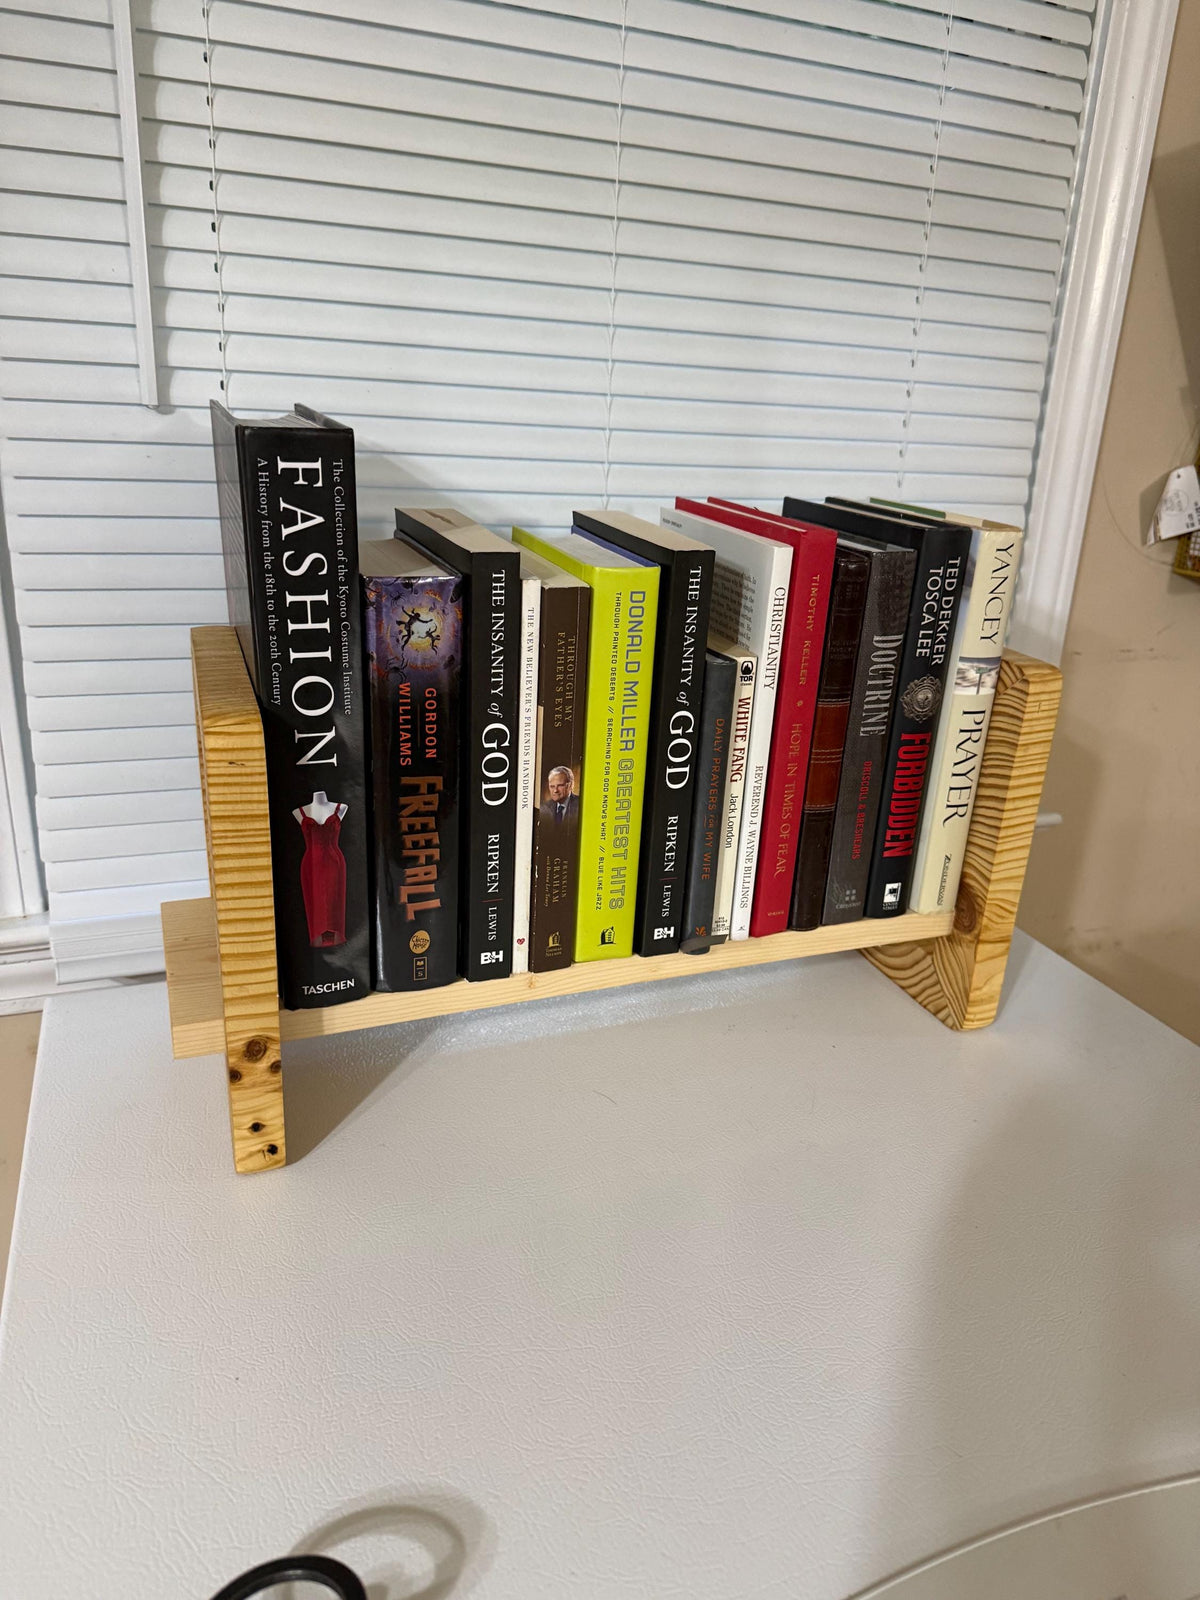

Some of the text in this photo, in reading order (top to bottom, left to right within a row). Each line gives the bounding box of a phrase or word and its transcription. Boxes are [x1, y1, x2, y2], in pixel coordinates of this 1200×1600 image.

[257, 457, 282, 706] A History from the 18th to the 20th Century
[332, 459, 352, 714] The Collection of the Kyoto Costume Institute
[980, 542, 1015, 645] YANCEY
[277, 456, 338, 767] FASHION
[527, 607, 535, 628] THE
[614, 592, 622, 629] THROUGH
[763, 587, 786, 690] CHRISTIANITY
[915, 566, 944, 658] TOSCA LEE
[931, 557, 961, 666] TED DEKKER
[611, 631, 619, 665] PAINTED
[481, 570, 510, 807] THE INSANITY of GOD
[525, 657, 533, 713] BELIEVER'S
[554, 632, 566, 728] FATHER'S EYES
[564, 636, 575, 722] THROUGH MY
[608, 667, 617, 701] DESERTS
[665, 566, 702, 790] THE INSANITY of GOD
[860, 634, 904, 737] DOCTRINE
[399, 682, 412, 767] WILLIAMS
[425, 687, 437, 759] GORDON
[523, 716, 532, 761] FRIENDS
[605, 718, 613, 759] SEARCHING
[713, 718, 725, 753] DAILY
[733, 697, 752, 744] WHITE
[774, 574, 820, 880] TIMOTHY KELLER HOPE IN TIMES OF FEAR
[609, 590, 646, 910] DONALD MILLER GREATEST HITS
[730, 746, 748, 783] FANG
[942, 709, 986, 828] PRAYER
[521, 760, 531, 810] HANDBOOK
[708, 758, 721, 811] PRAYERS
[750, 765, 764, 818] REVEREND
[859, 760, 873, 802] DRISCOLL
[882, 732, 932, 858] FORBIDDEN
[399, 775, 443, 922] FREEFALL
[664, 815, 679, 873] RIPKEN
[705, 831, 713, 848] MY
[725, 793, 739, 849] Jack London
[745, 829, 756, 864] WAYNE
[487, 833, 500, 894] RIPKEN
[701, 855, 712, 880] WIFE
[740, 865, 753, 909] BILLINGS
[488, 906, 497, 941] LEWIS
[661, 885, 672, 917] LEWIS
[480, 950, 504, 965] B&H
[653, 926, 675, 940] B&H
[302, 978, 355, 996] TASCHEN
